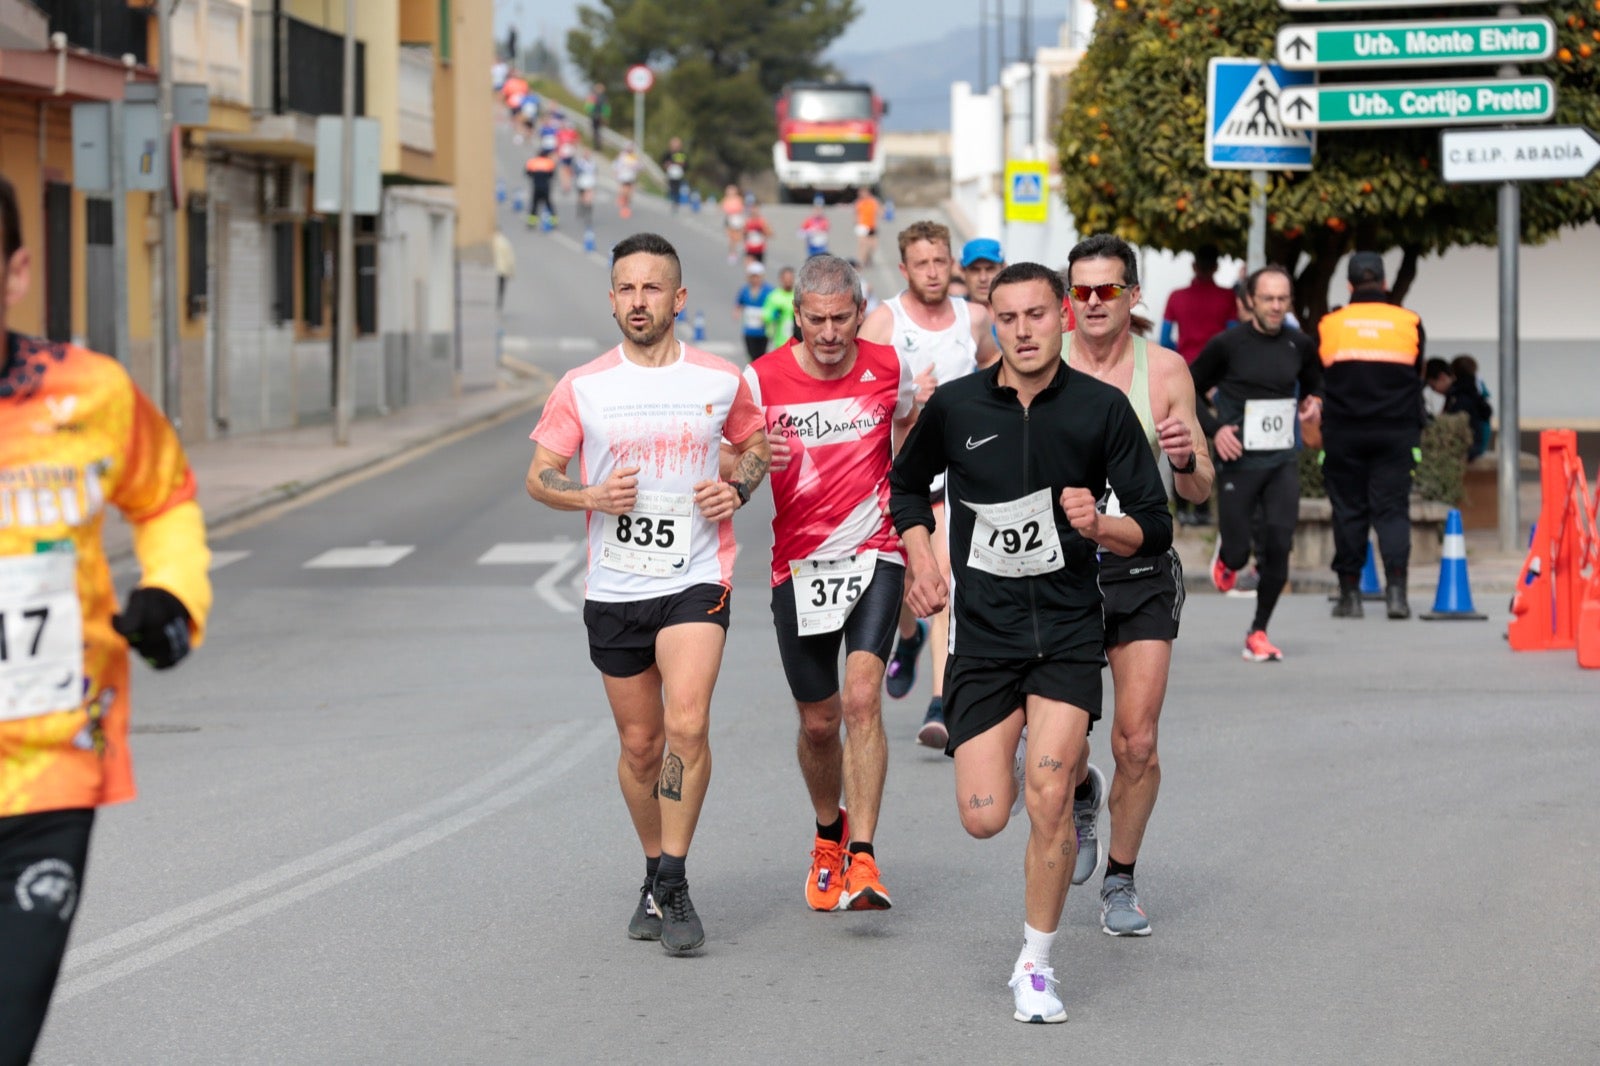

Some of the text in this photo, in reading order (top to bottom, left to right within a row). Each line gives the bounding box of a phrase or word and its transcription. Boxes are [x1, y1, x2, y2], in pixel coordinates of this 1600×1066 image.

[1353, 27, 1541, 56] Urb. Monte Elvira
[1348, 86, 1542, 118] Urb. Cortijo Pretel
[1515, 142, 1584, 161] ABADÍA
[1261, 414, 1283, 433] 60
[615, 513, 676, 549] 835
[810, 575, 862, 608] 375
